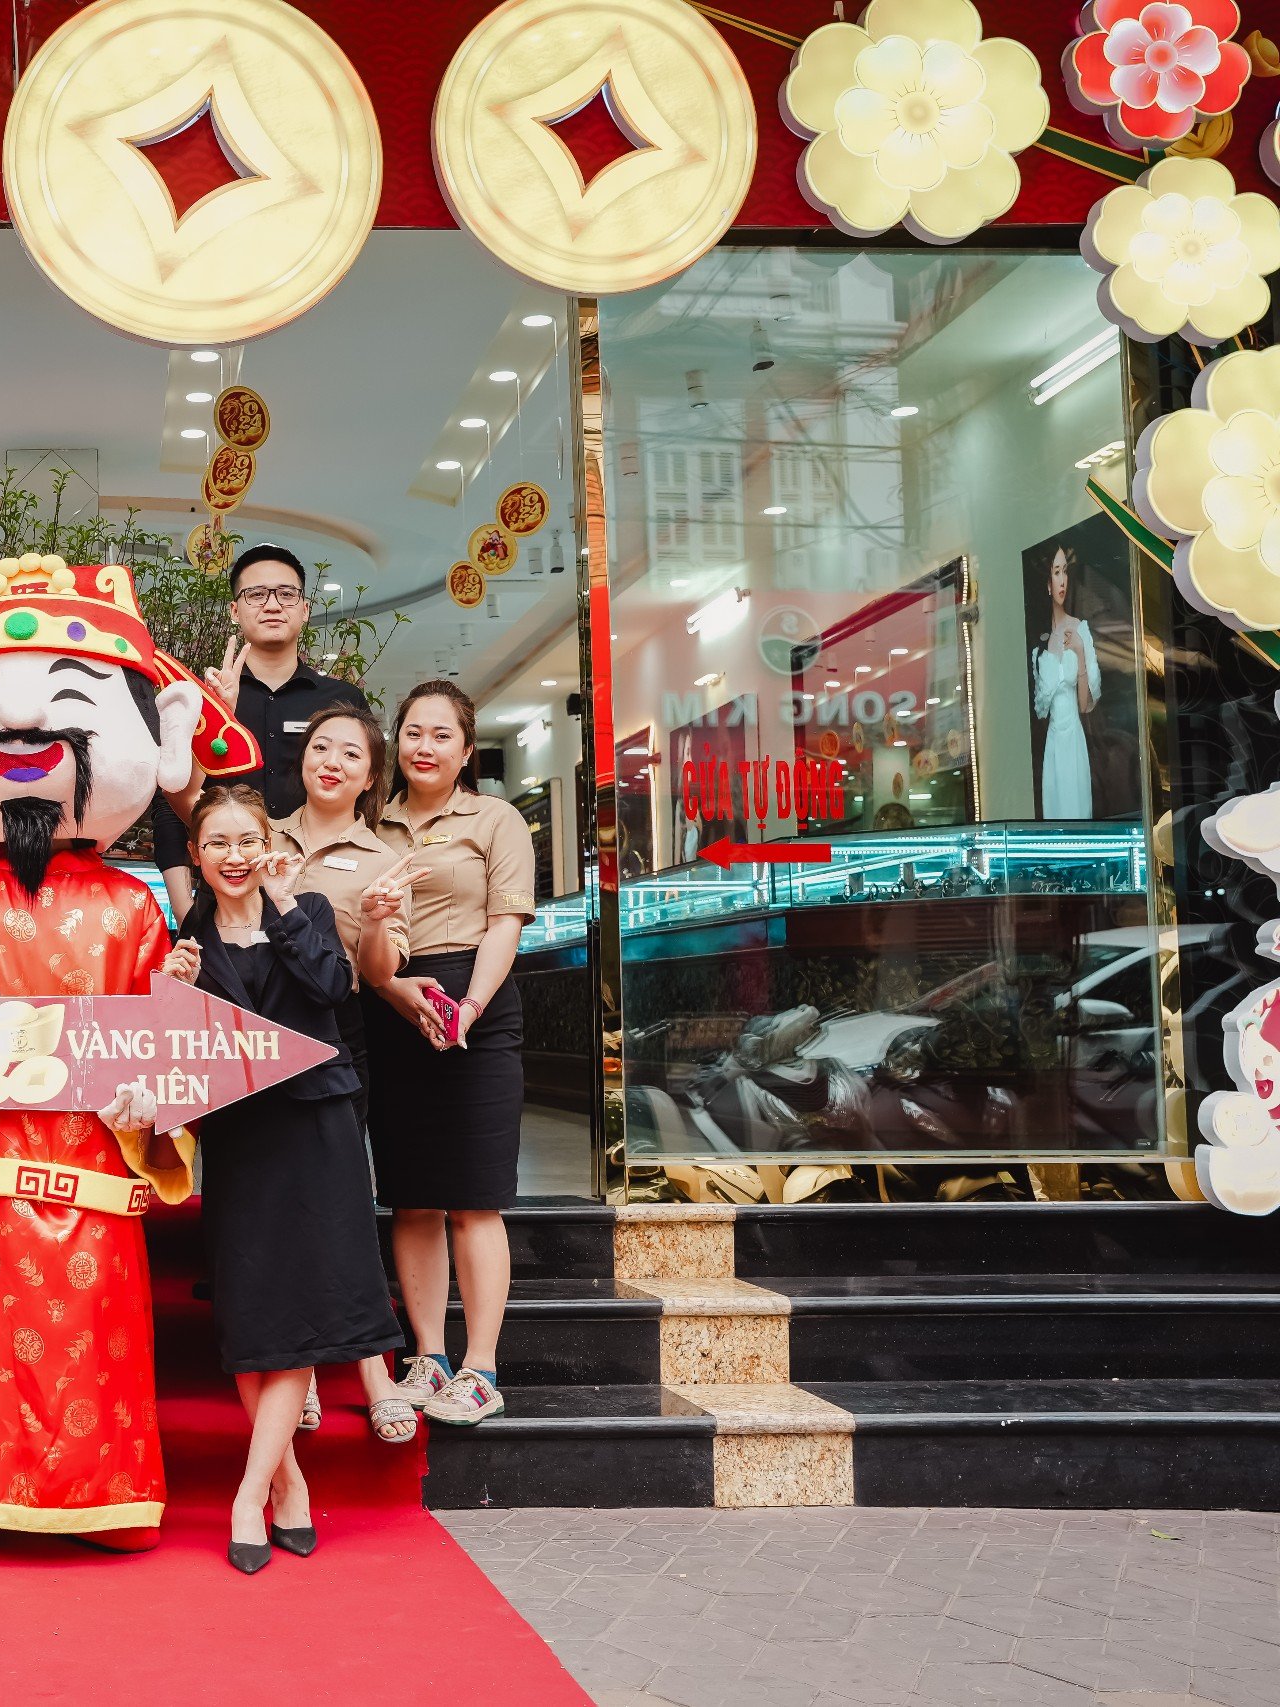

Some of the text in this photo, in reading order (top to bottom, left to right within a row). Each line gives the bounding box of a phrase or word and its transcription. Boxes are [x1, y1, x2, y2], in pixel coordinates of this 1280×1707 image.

[683, 742, 845, 829] CỬA TỰ ĐỘNG
[66, 1021, 156, 1060] VÀNG
[165, 1021, 281, 1060] THÀNH
